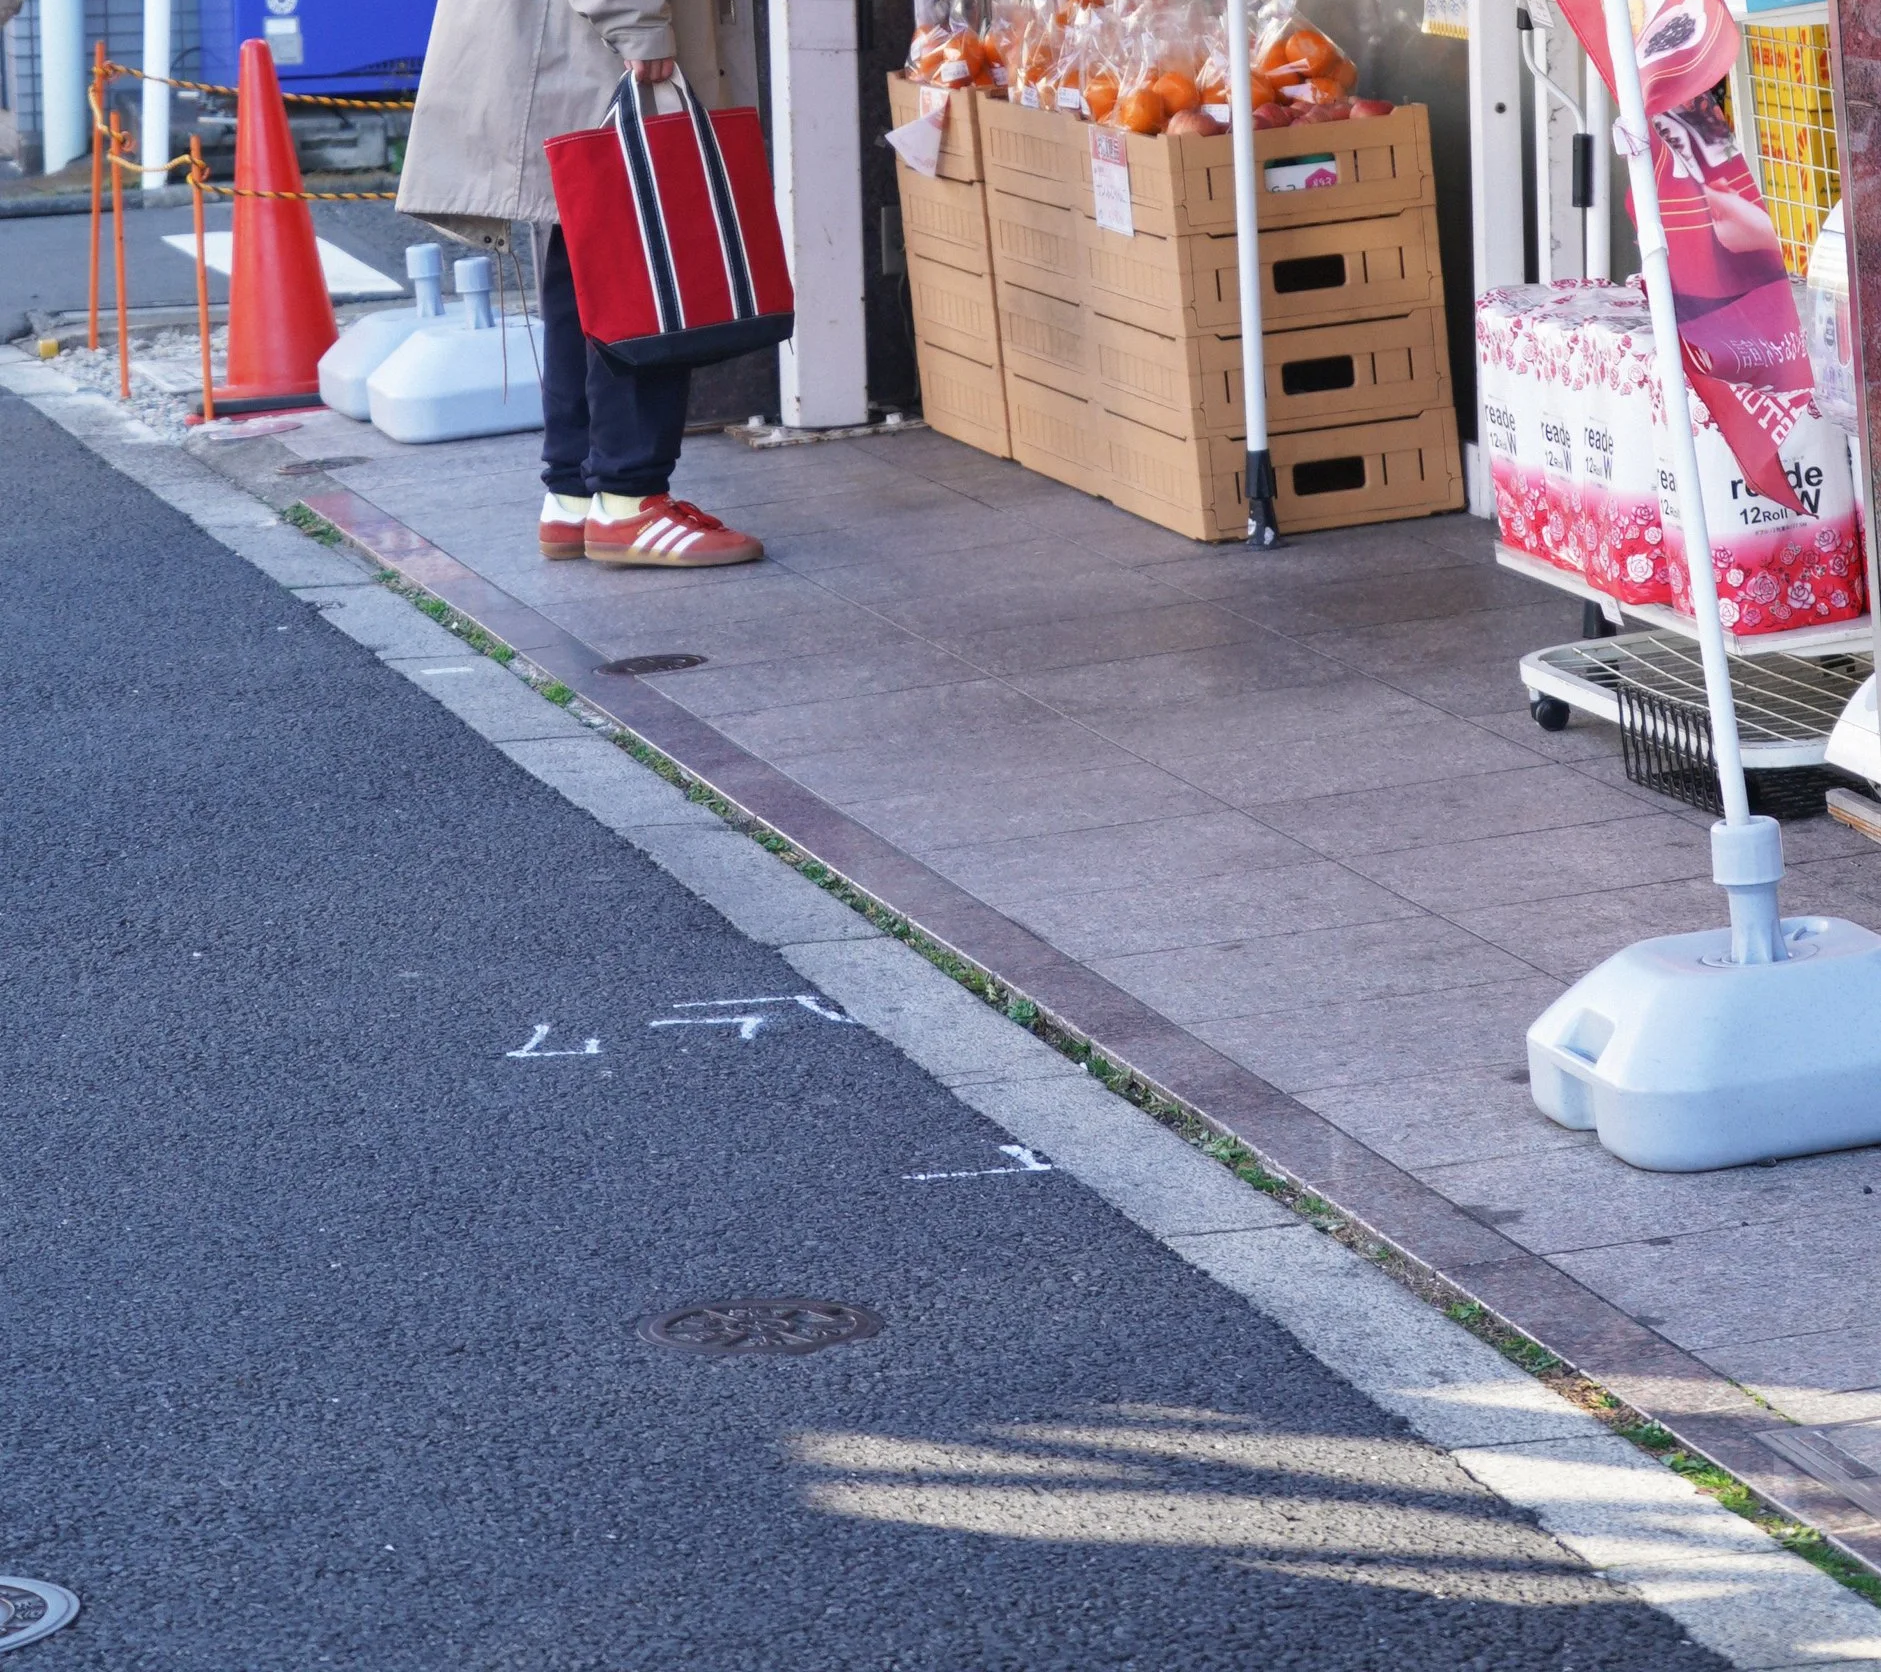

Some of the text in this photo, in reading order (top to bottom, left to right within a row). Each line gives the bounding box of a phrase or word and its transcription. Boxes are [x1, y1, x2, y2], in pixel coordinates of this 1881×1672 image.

[1484, 403, 1516, 432] reade
[1507, 432, 1518, 456] W
[1540, 421, 1571, 449] reade
[1584, 426, 1614, 455] reade
[1563, 450, 1573, 474] W
[1603, 455, 1613, 481] W
[1730, 461, 1823, 500] rde
[1740, 506, 1788, 526] 12Roll
